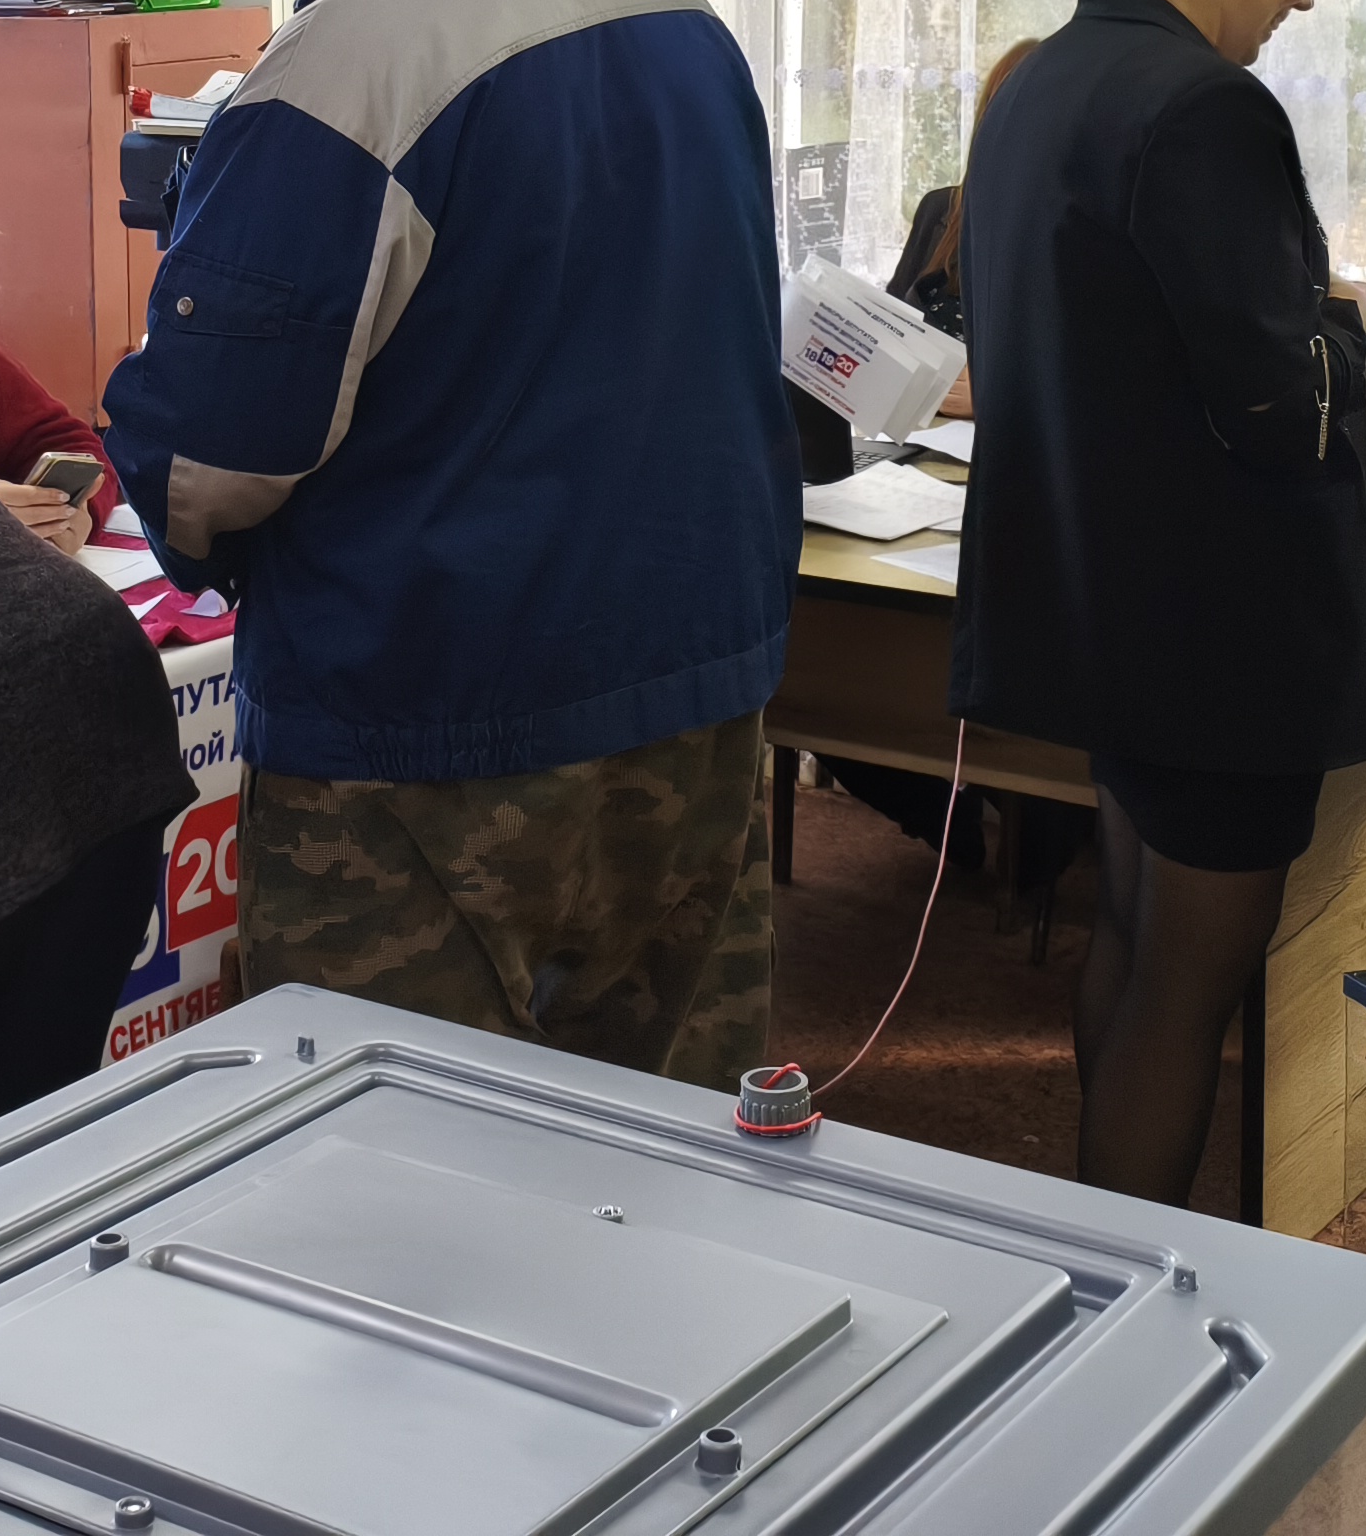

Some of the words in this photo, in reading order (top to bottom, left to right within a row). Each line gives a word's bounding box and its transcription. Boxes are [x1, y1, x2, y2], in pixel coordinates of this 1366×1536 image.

[804, 347, 818, 362] 18
[821, 351, 835, 367] 19
[836, 356, 854, 373] 20
[177, 825, 237, 915] 20
